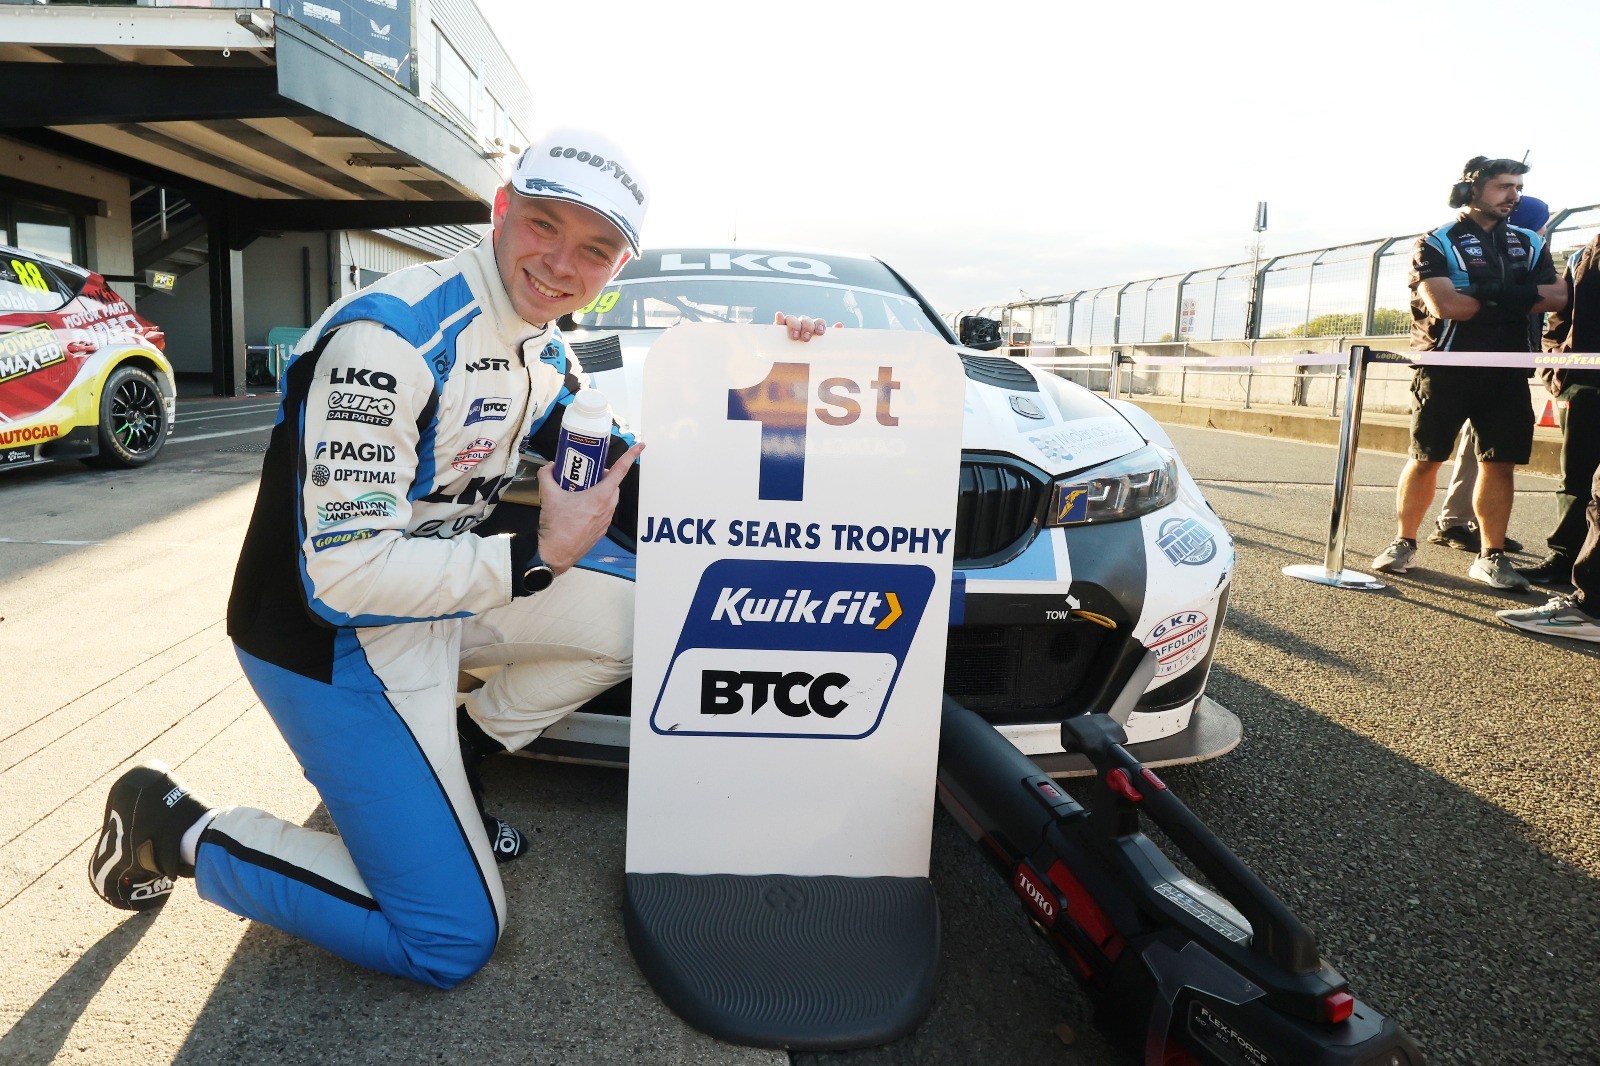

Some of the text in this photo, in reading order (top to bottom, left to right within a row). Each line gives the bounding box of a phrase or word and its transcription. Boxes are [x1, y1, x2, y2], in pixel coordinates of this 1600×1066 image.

[550, 146, 645, 205] GOODYEAR
[11, 259, 50, 296] 88
[660, 253, 840, 280] LKQ
[62, 301, 129, 328] MOTOR PARTS
[0, 343, 60, 377] MAXED
[466, 358, 510, 373] WSR
[330, 368, 397, 394] LKQ
[328, 391, 395, 416] euro
[484, 403, 507, 412] BTCC
[352, 413, 389, 425] PARTS
[727, 361, 901, 502] 1st
[330, 441, 396, 462] PAGID
[334, 469, 397, 484] OPTIMAL
[570, 456, 582, 481] BTCC
[640, 516, 952, 554] JACK SEARS TROPHY
[1045, 611, 1068, 620] TOW
[1153, 614, 1198, 638] GKR
[1155, 624, 1208, 657] AFFOLDING
[1160, 647, 1196, 672] IMITED
[700, 669, 851, 719] BTCC
[1020, 873, 1053, 916] TORO
[1201, 1007, 1267, 1064] FLEX-FORCE
